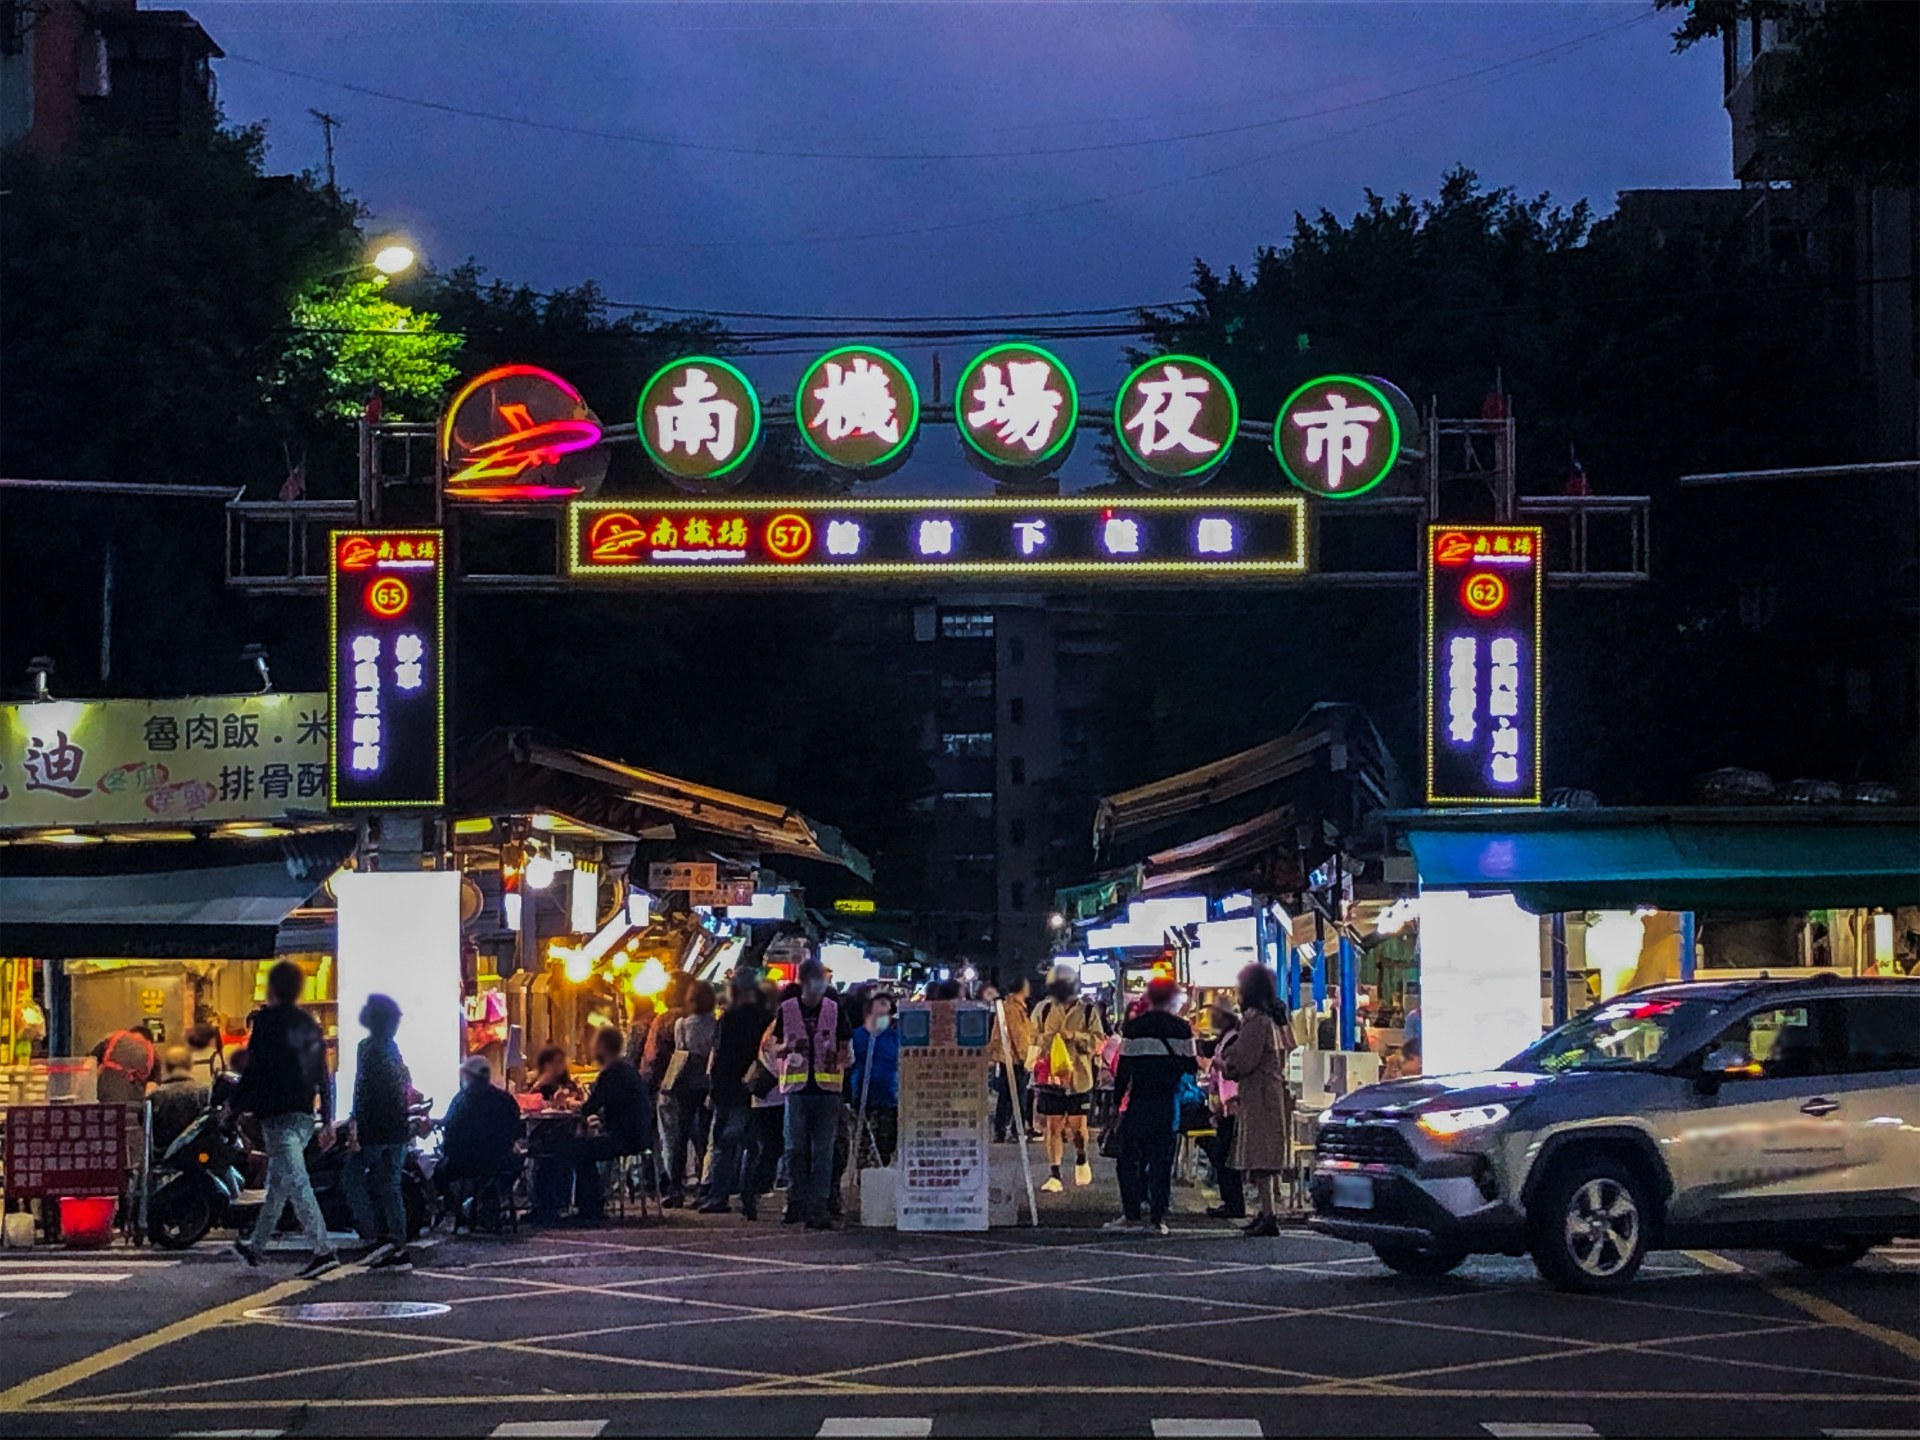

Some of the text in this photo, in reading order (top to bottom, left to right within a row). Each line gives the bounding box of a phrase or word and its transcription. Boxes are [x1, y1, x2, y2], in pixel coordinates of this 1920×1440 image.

[654, 357, 1381, 488] 南機場夜市
